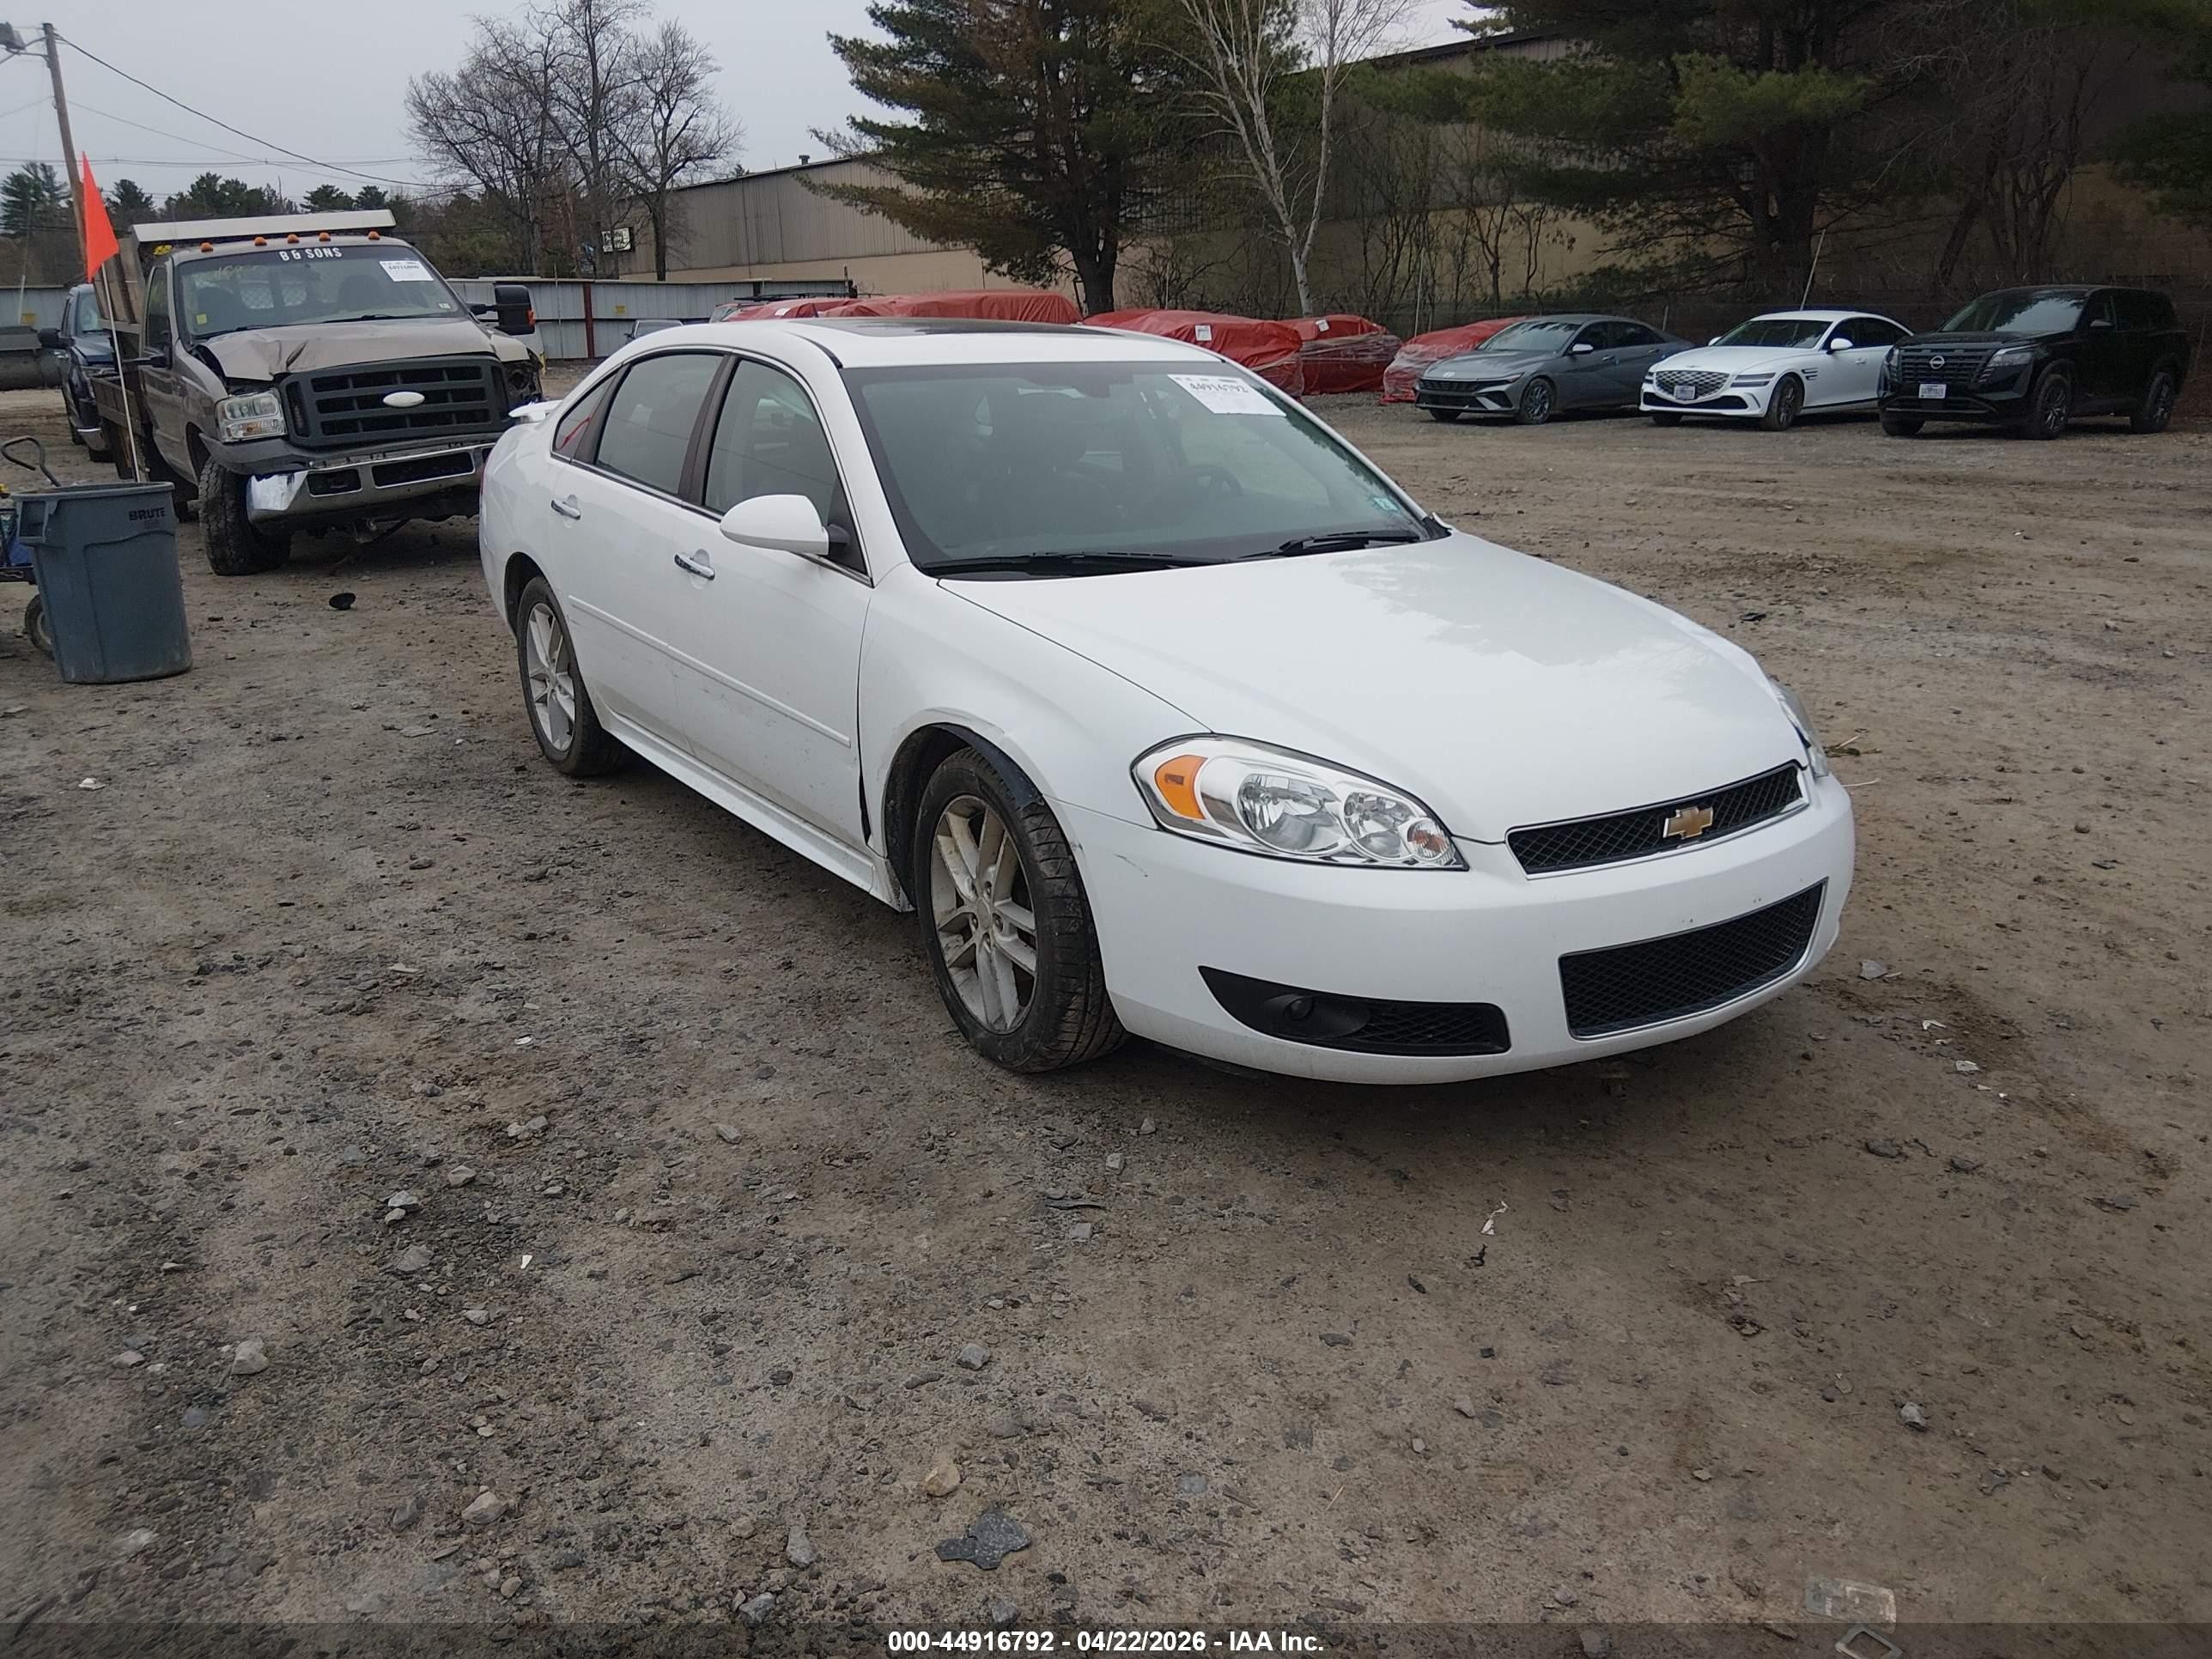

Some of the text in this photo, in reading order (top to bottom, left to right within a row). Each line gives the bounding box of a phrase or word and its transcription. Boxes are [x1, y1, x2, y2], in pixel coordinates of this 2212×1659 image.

[279, 247, 343, 261] B & SONS
[129, 507, 166, 521] BRUTE
